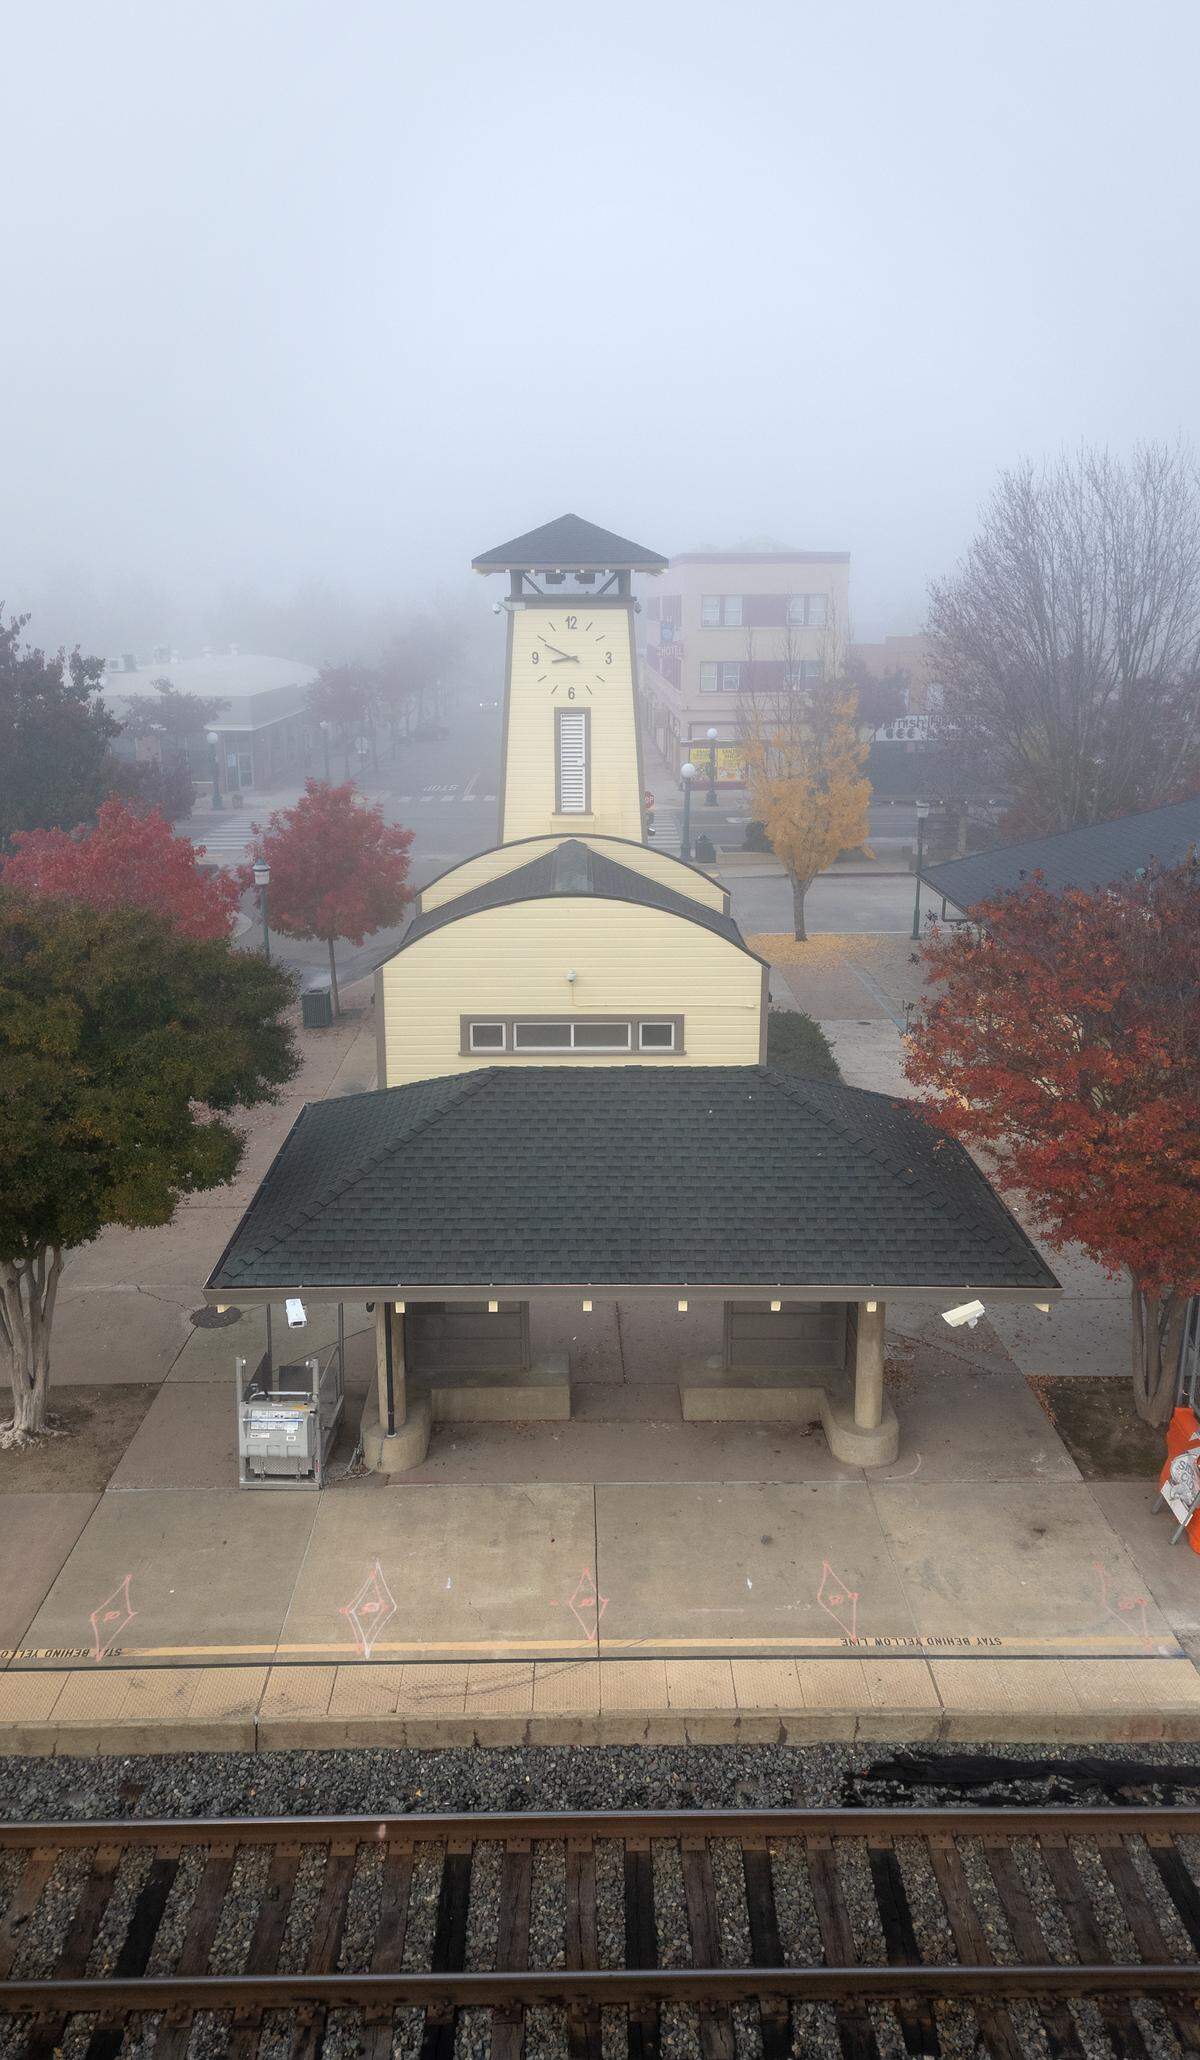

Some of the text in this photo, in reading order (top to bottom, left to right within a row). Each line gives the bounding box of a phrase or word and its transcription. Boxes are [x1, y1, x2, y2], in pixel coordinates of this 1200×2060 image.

[564, 616, 578, 630] 12
[531, 651, 539, 665] 9
[605, 651, 613, 665] 3
[568, 687, 575, 700] 6
[840, 1638, 1002, 1647] STAY BEHIND YELLOW LINE
[0, 1649, 39, 1659] YELLO
[45, 1649, 90, 1658] BEHIND
